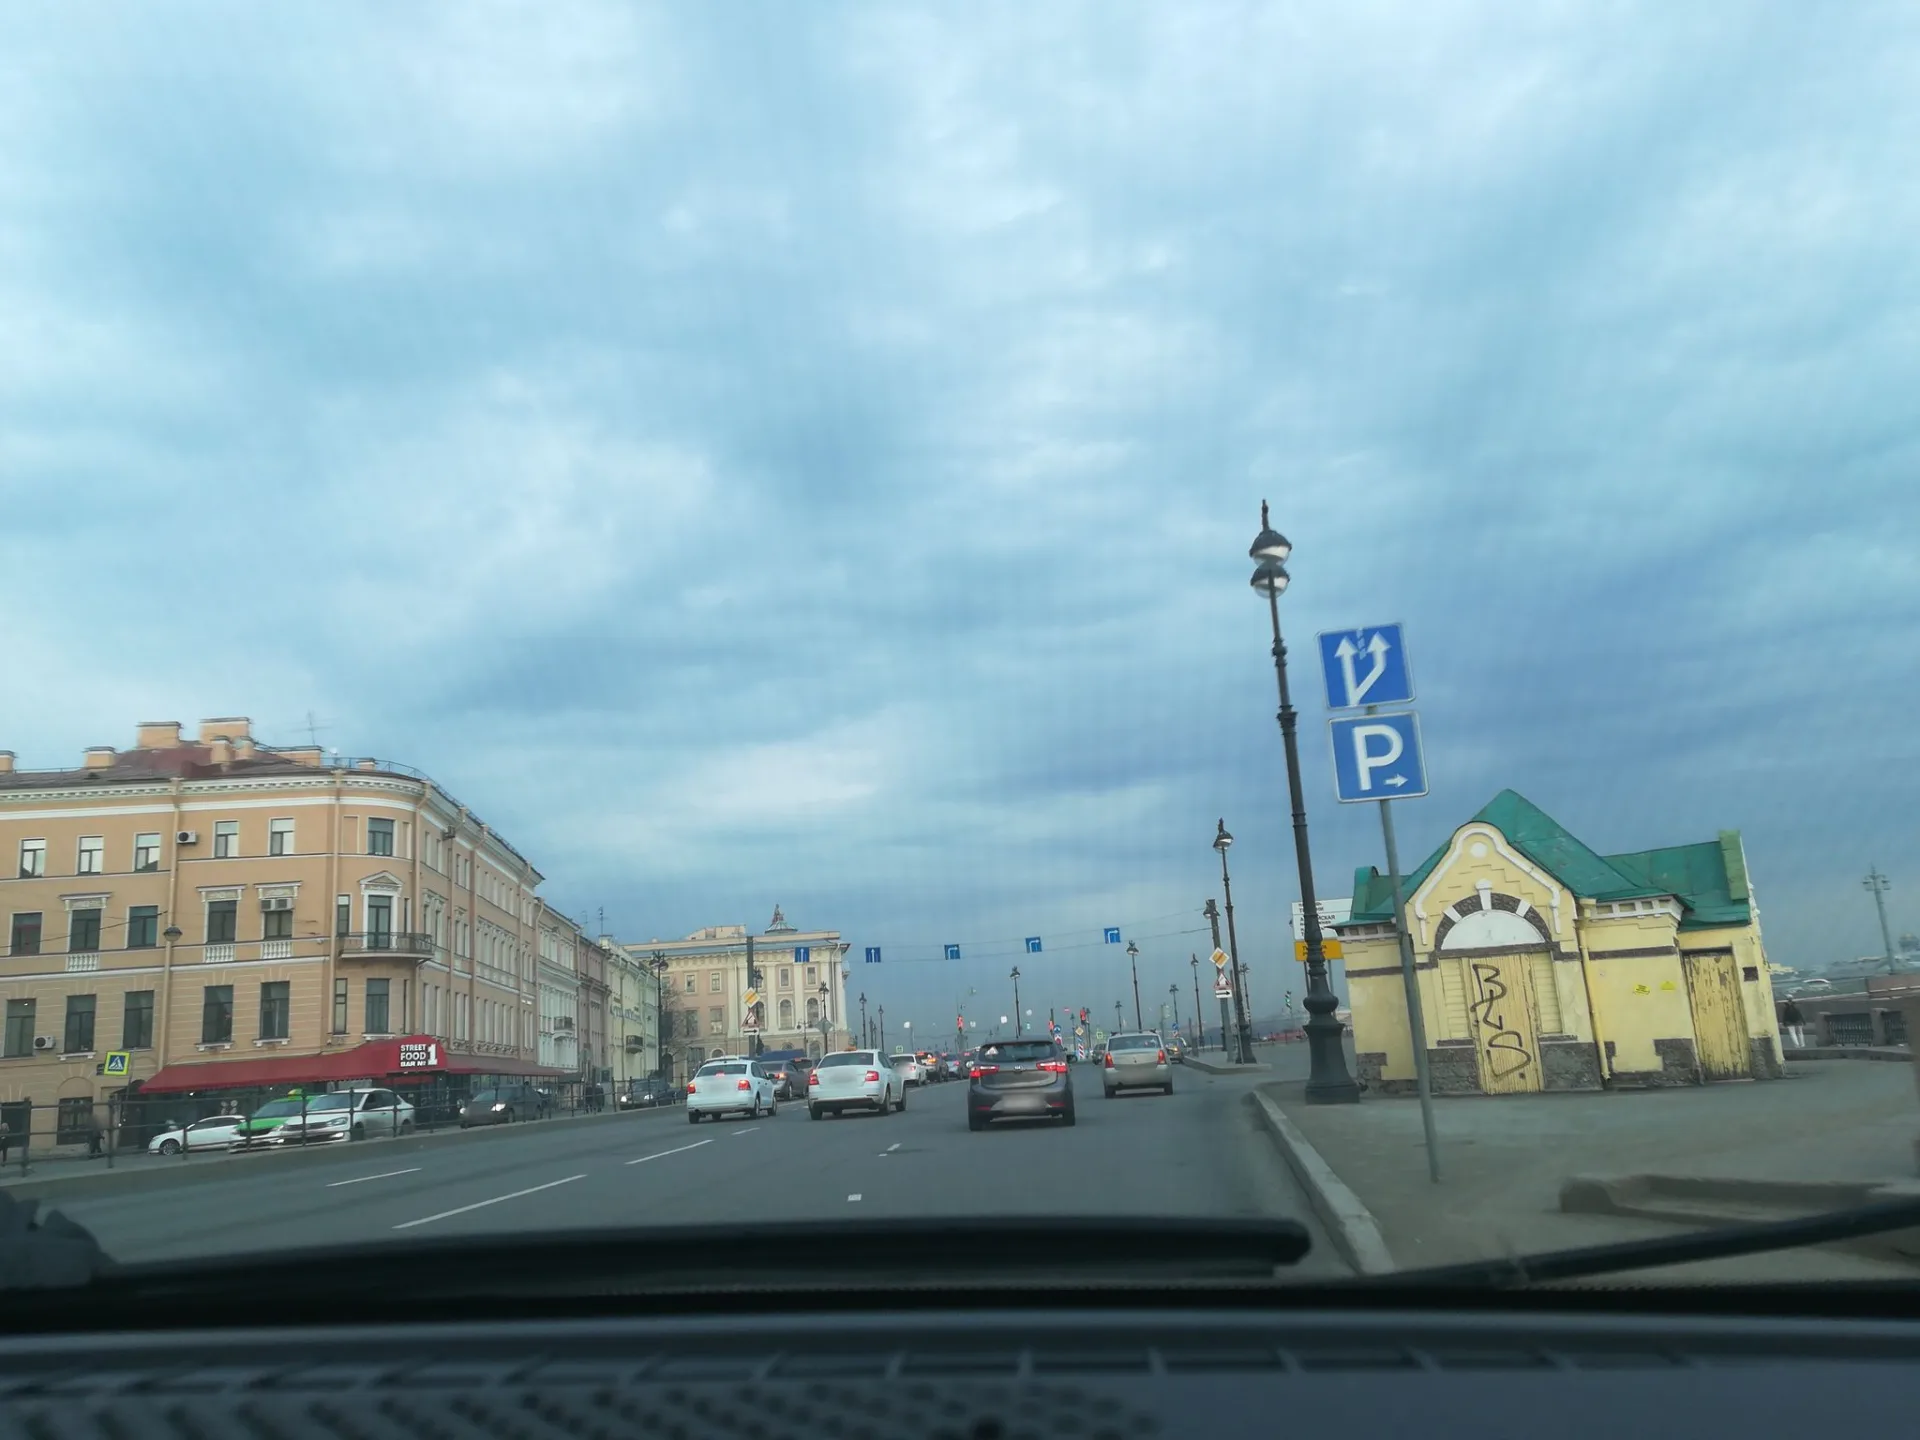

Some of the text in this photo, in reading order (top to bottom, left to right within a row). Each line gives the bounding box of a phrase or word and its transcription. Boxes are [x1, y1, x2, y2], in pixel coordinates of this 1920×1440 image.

[1352, 724, 1403, 790] P
[400, 1044, 426, 1052] STREET
[428, 1044, 438, 1065] 1
[400, 1051, 426, 1061] FOOD
